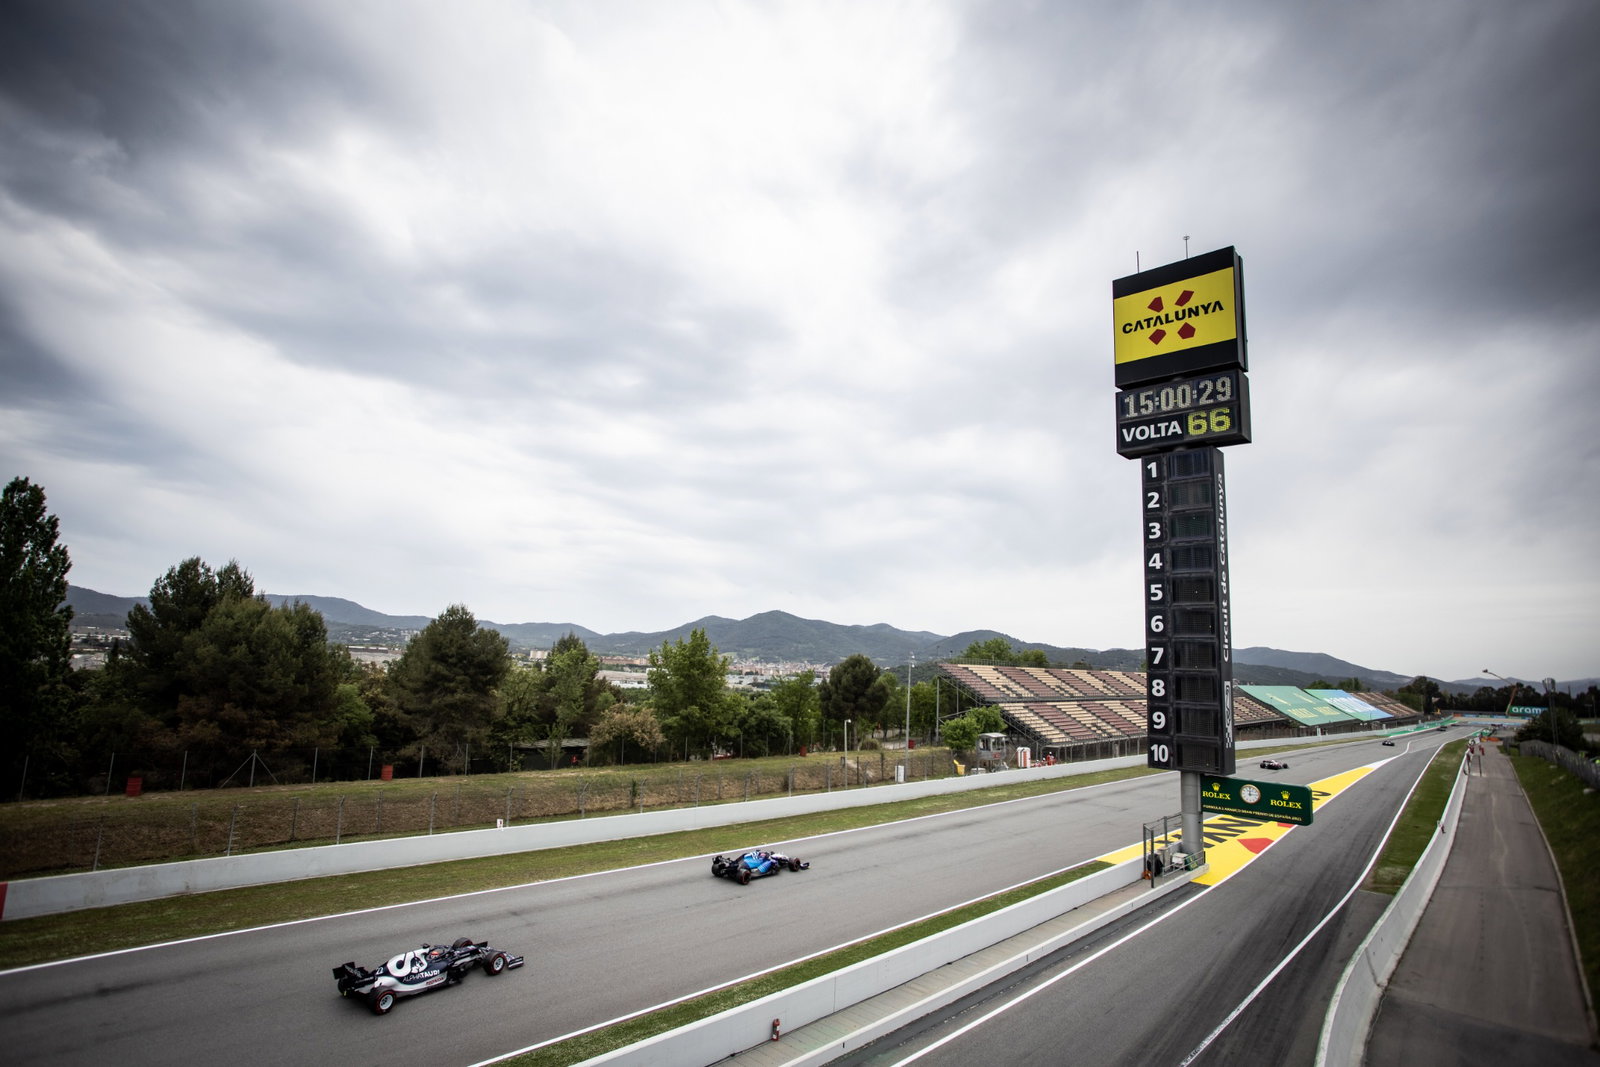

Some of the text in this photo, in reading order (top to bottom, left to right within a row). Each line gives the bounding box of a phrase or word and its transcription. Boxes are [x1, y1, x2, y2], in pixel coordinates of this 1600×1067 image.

[1122, 300, 1224, 334] CATALUNYA
[1124, 376, 1232, 418] 15:00:29
[1122, 407, 1231, 442] VOLTA 66
[1147, 462, 1158, 478] 1
[1147, 492, 1160, 508] 2
[1218, 474, 1226, 565] Catalunya
[1148, 522, 1161, 539] 3
[1148, 553, 1163, 570] 4
[1220, 571, 1227, 594] de
[1150, 584, 1163, 601] 5
[1150, 615, 1164, 632] 6
[1151, 647, 1164, 664] 7
[1151, 679, 1165, 697] 8
[1152, 711, 1166, 729] 9
[1150, 744, 1169, 762] 10
[1202, 791, 1230, 799] ROLEX
[1270, 800, 1302, 808] ROLEX
